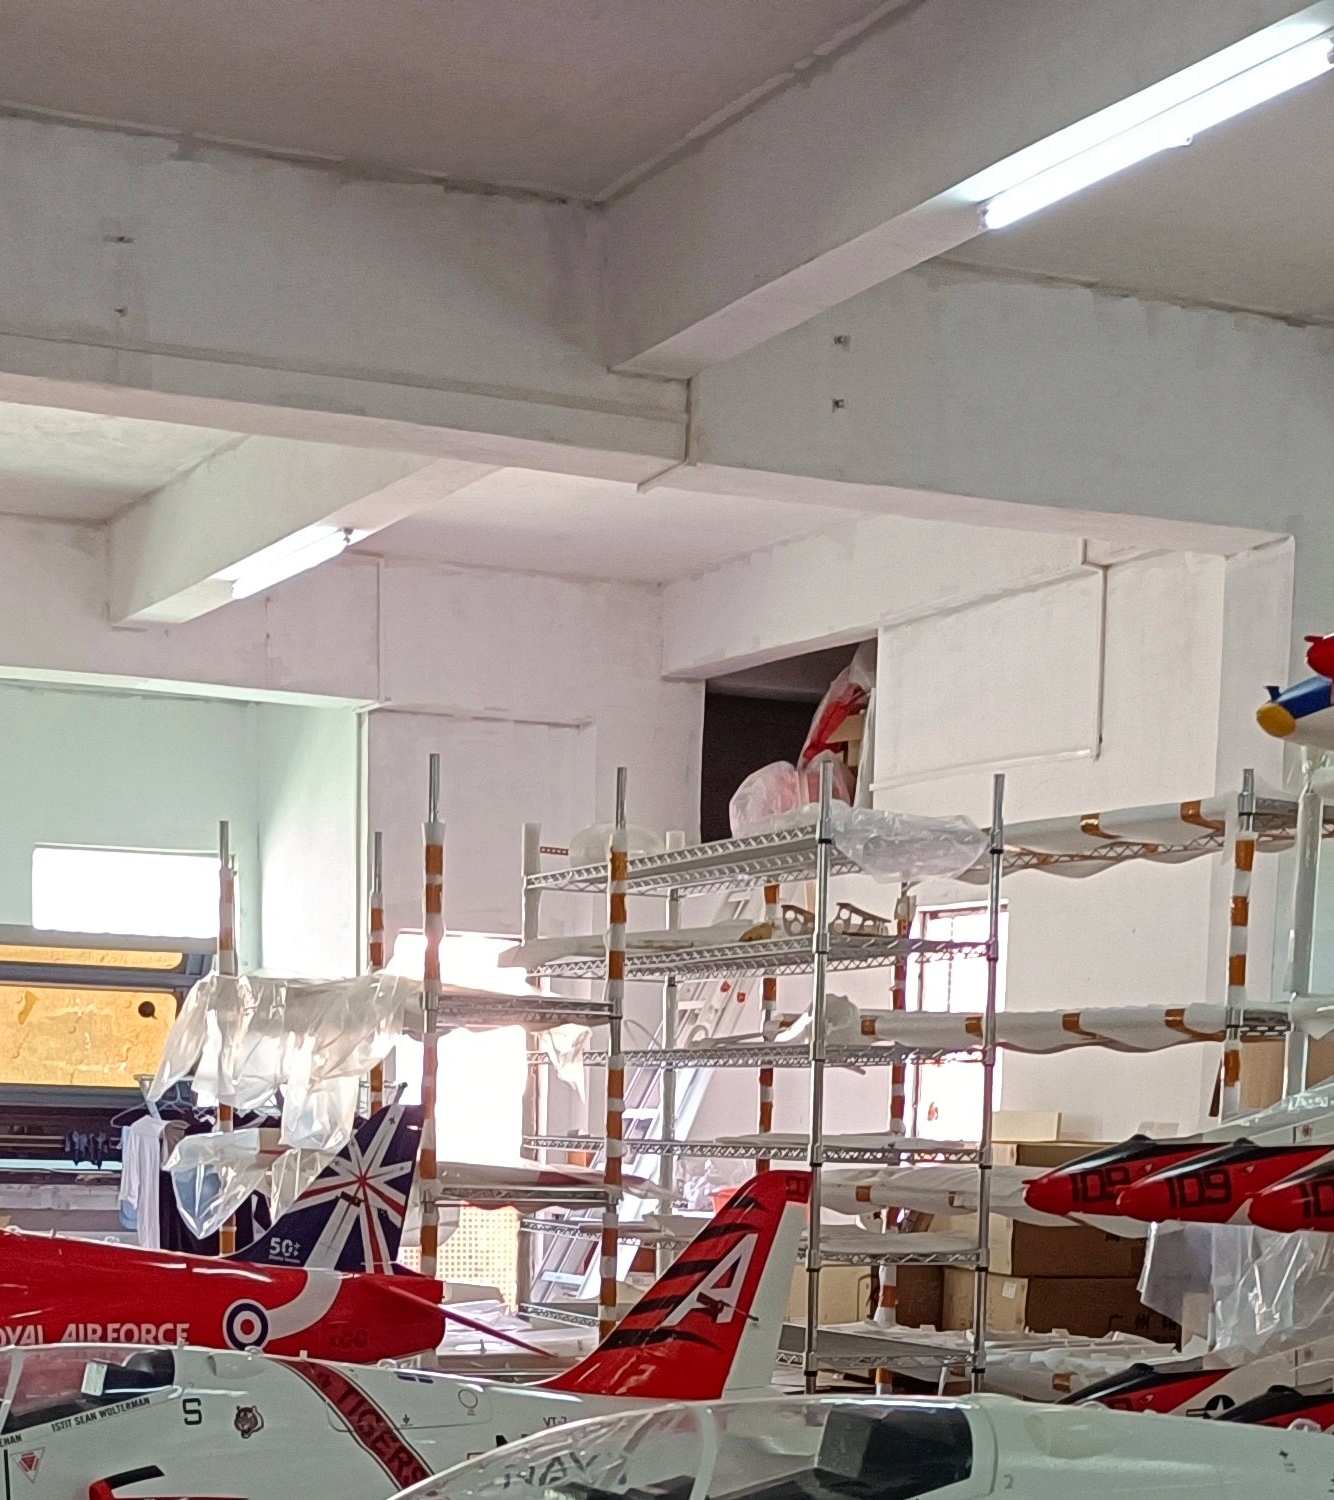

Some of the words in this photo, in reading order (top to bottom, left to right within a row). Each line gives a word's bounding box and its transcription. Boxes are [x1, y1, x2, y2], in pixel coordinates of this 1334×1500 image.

[1167, 1167, 1233, 1208] 109
[657, 1233, 760, 1324] A
[74, 1411, 97, 1426] SEAN
[98, 1396, 151, 1417] WOLTERMAN
[182, 1398, 202, 1426] S
